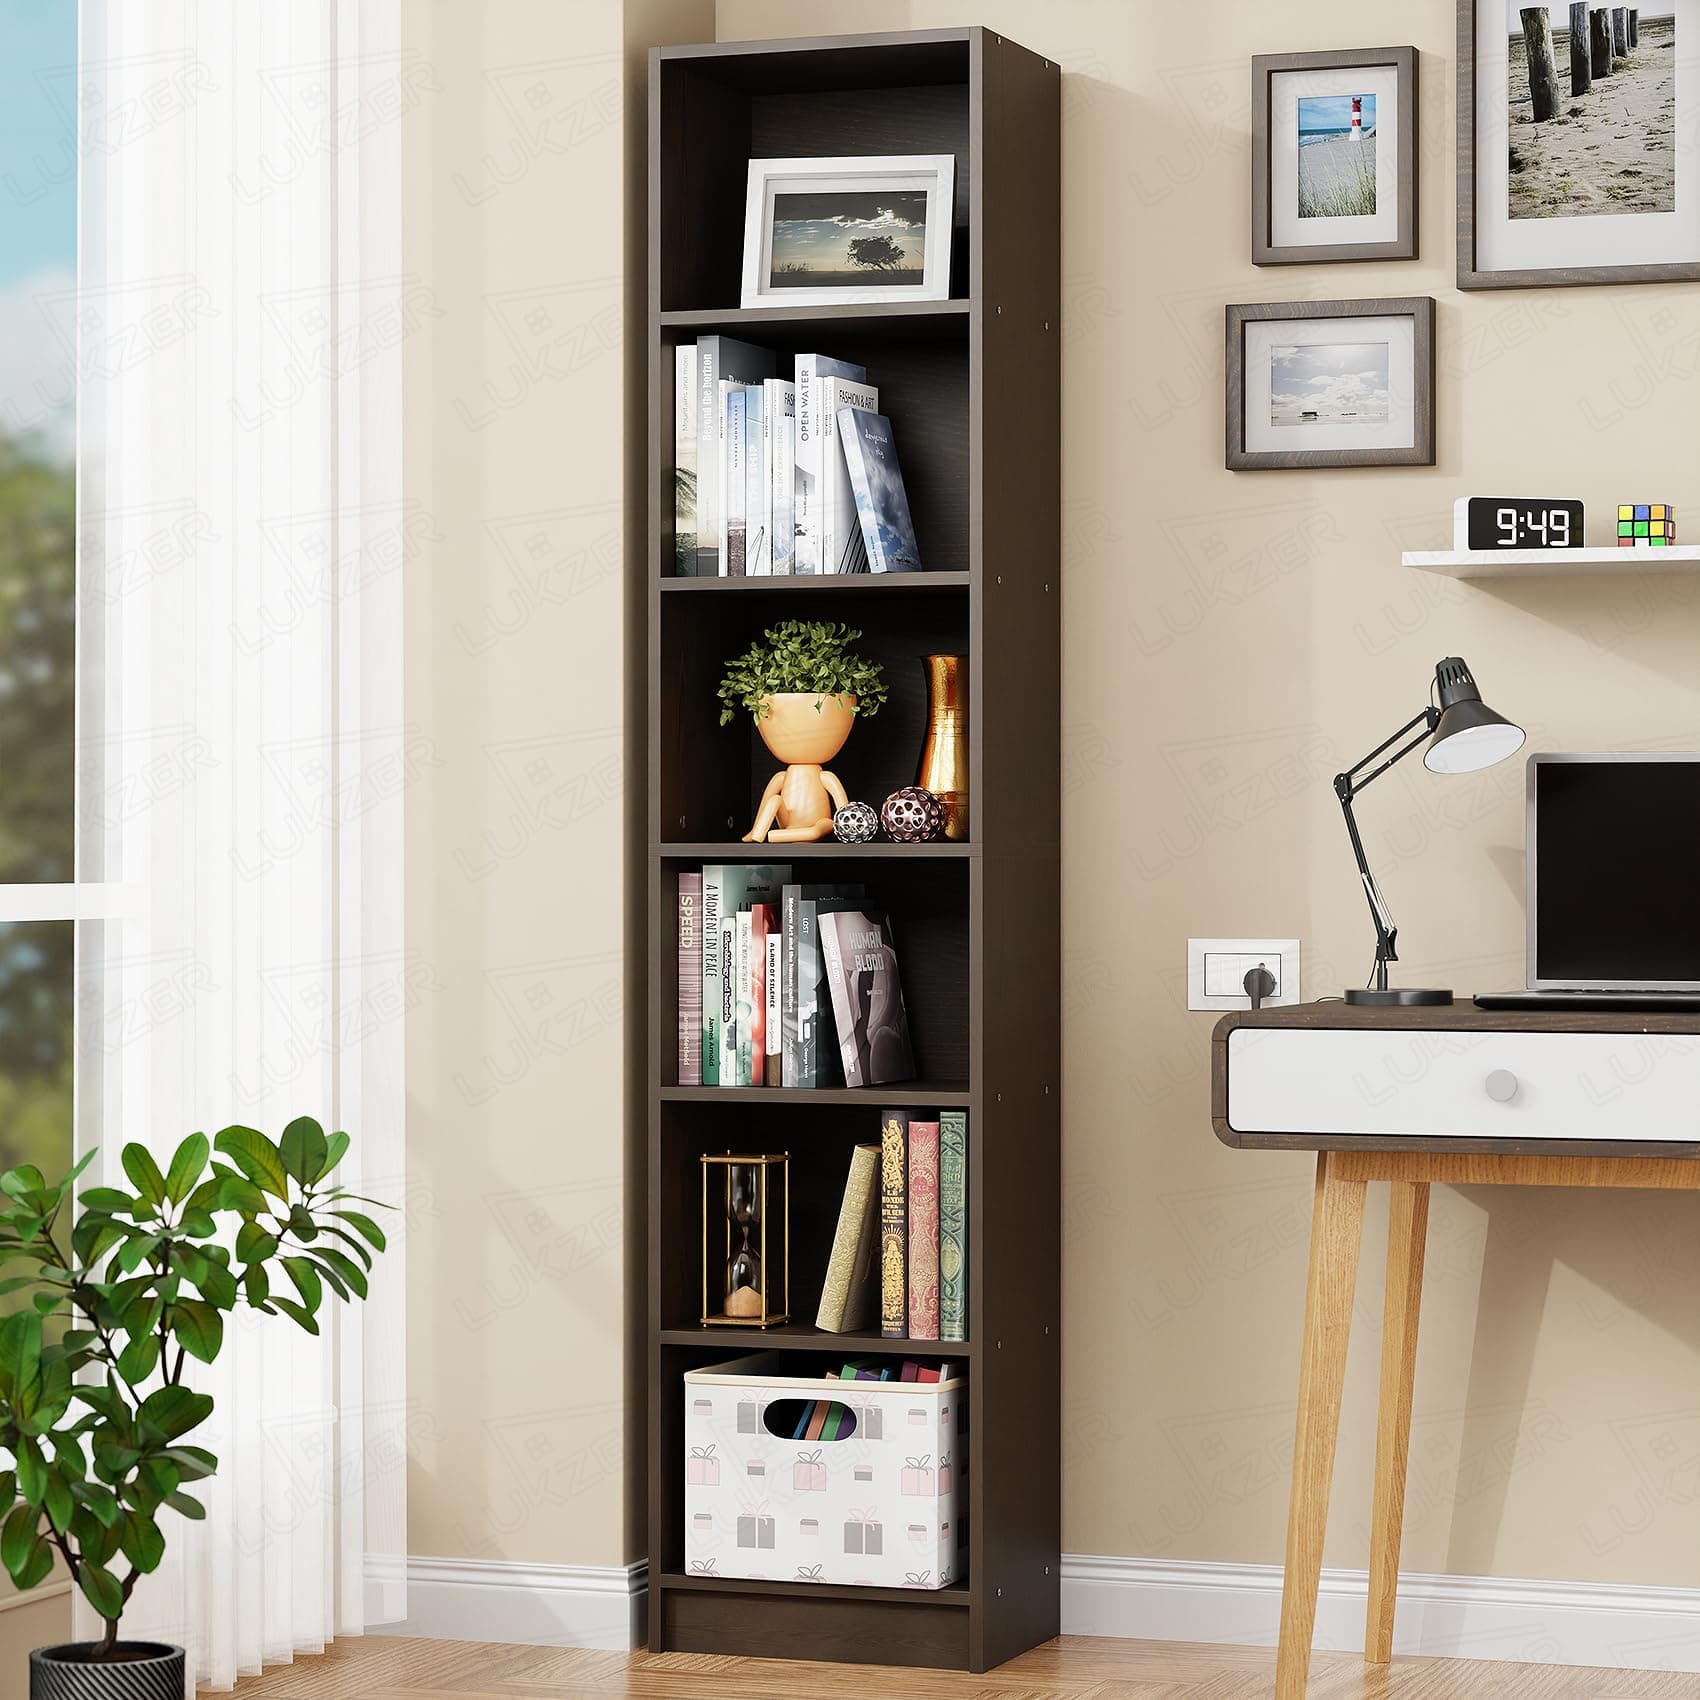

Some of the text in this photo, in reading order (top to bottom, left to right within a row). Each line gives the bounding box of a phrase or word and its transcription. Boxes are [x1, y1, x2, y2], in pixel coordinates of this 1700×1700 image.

[702, 353, 714, 442] Beyond the horizon
[800, 369, 810, 442] OPEN WATER
[1496, 508, 1570, 547] 9:49
[681, 895, 694, 949] SPEED
[705, 894, 719, 934] MOMENT
[705, 938, 718, 950] IN
[848, 931, 884, 950] HUMAN
[705, 954, 718, 977] PEACE
[722, 930, 732, 1023] Microbiology and bacteria
[769, 968, 776, 978] OF
[855, 953, 885, 972] BLOOD
